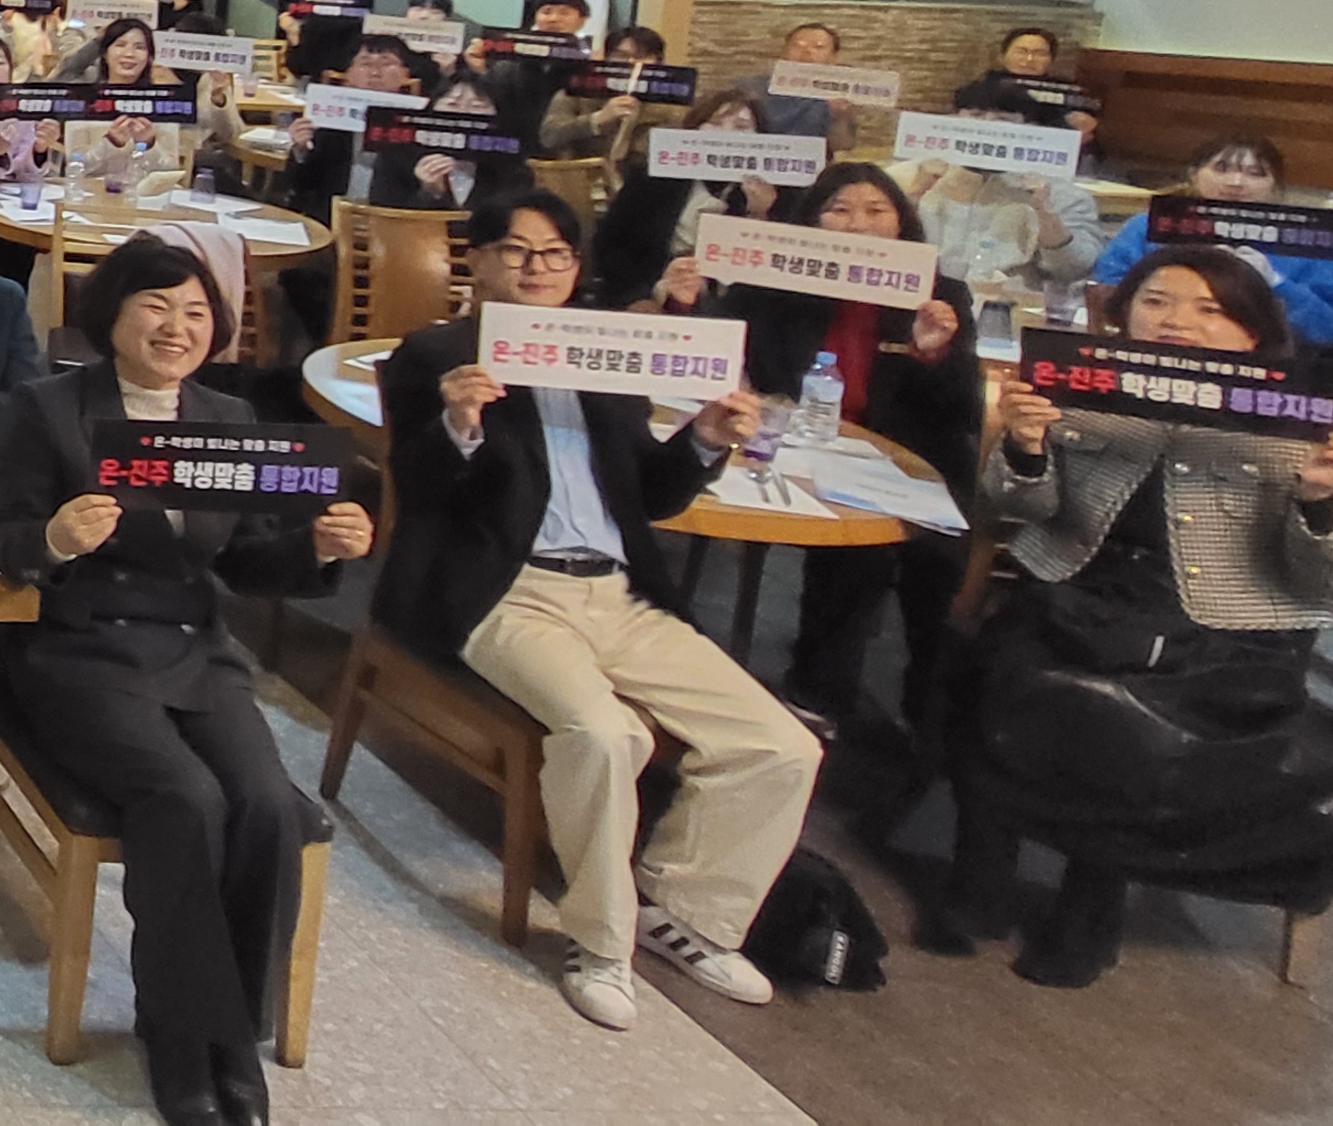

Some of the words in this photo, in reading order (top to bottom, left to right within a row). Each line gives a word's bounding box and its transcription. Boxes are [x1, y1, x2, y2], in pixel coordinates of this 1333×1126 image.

[158, 47, 176, 58] -진주
[706, 243, 764, 268] 온-진주
[770, 253, 841, 280] 학생맞춤
[847, 264, 921, 293] 통합지원
[493, 340, 559, 365] 온-진주
[566, 346, 642, 374] 학생맞춤
[650, 353, 728, 381] 통합지원
[1034, 359, 1116, 391] 온-진주
[1120, 370, 1223, 409] 학생맞춤
[1231, 386, 1333, 421] 통합지원
[99, 458, 169, 487] 온-진주
[173, 461, 256, 493] 학생맞춤
[259, 465, 339, 495] 통합지원
